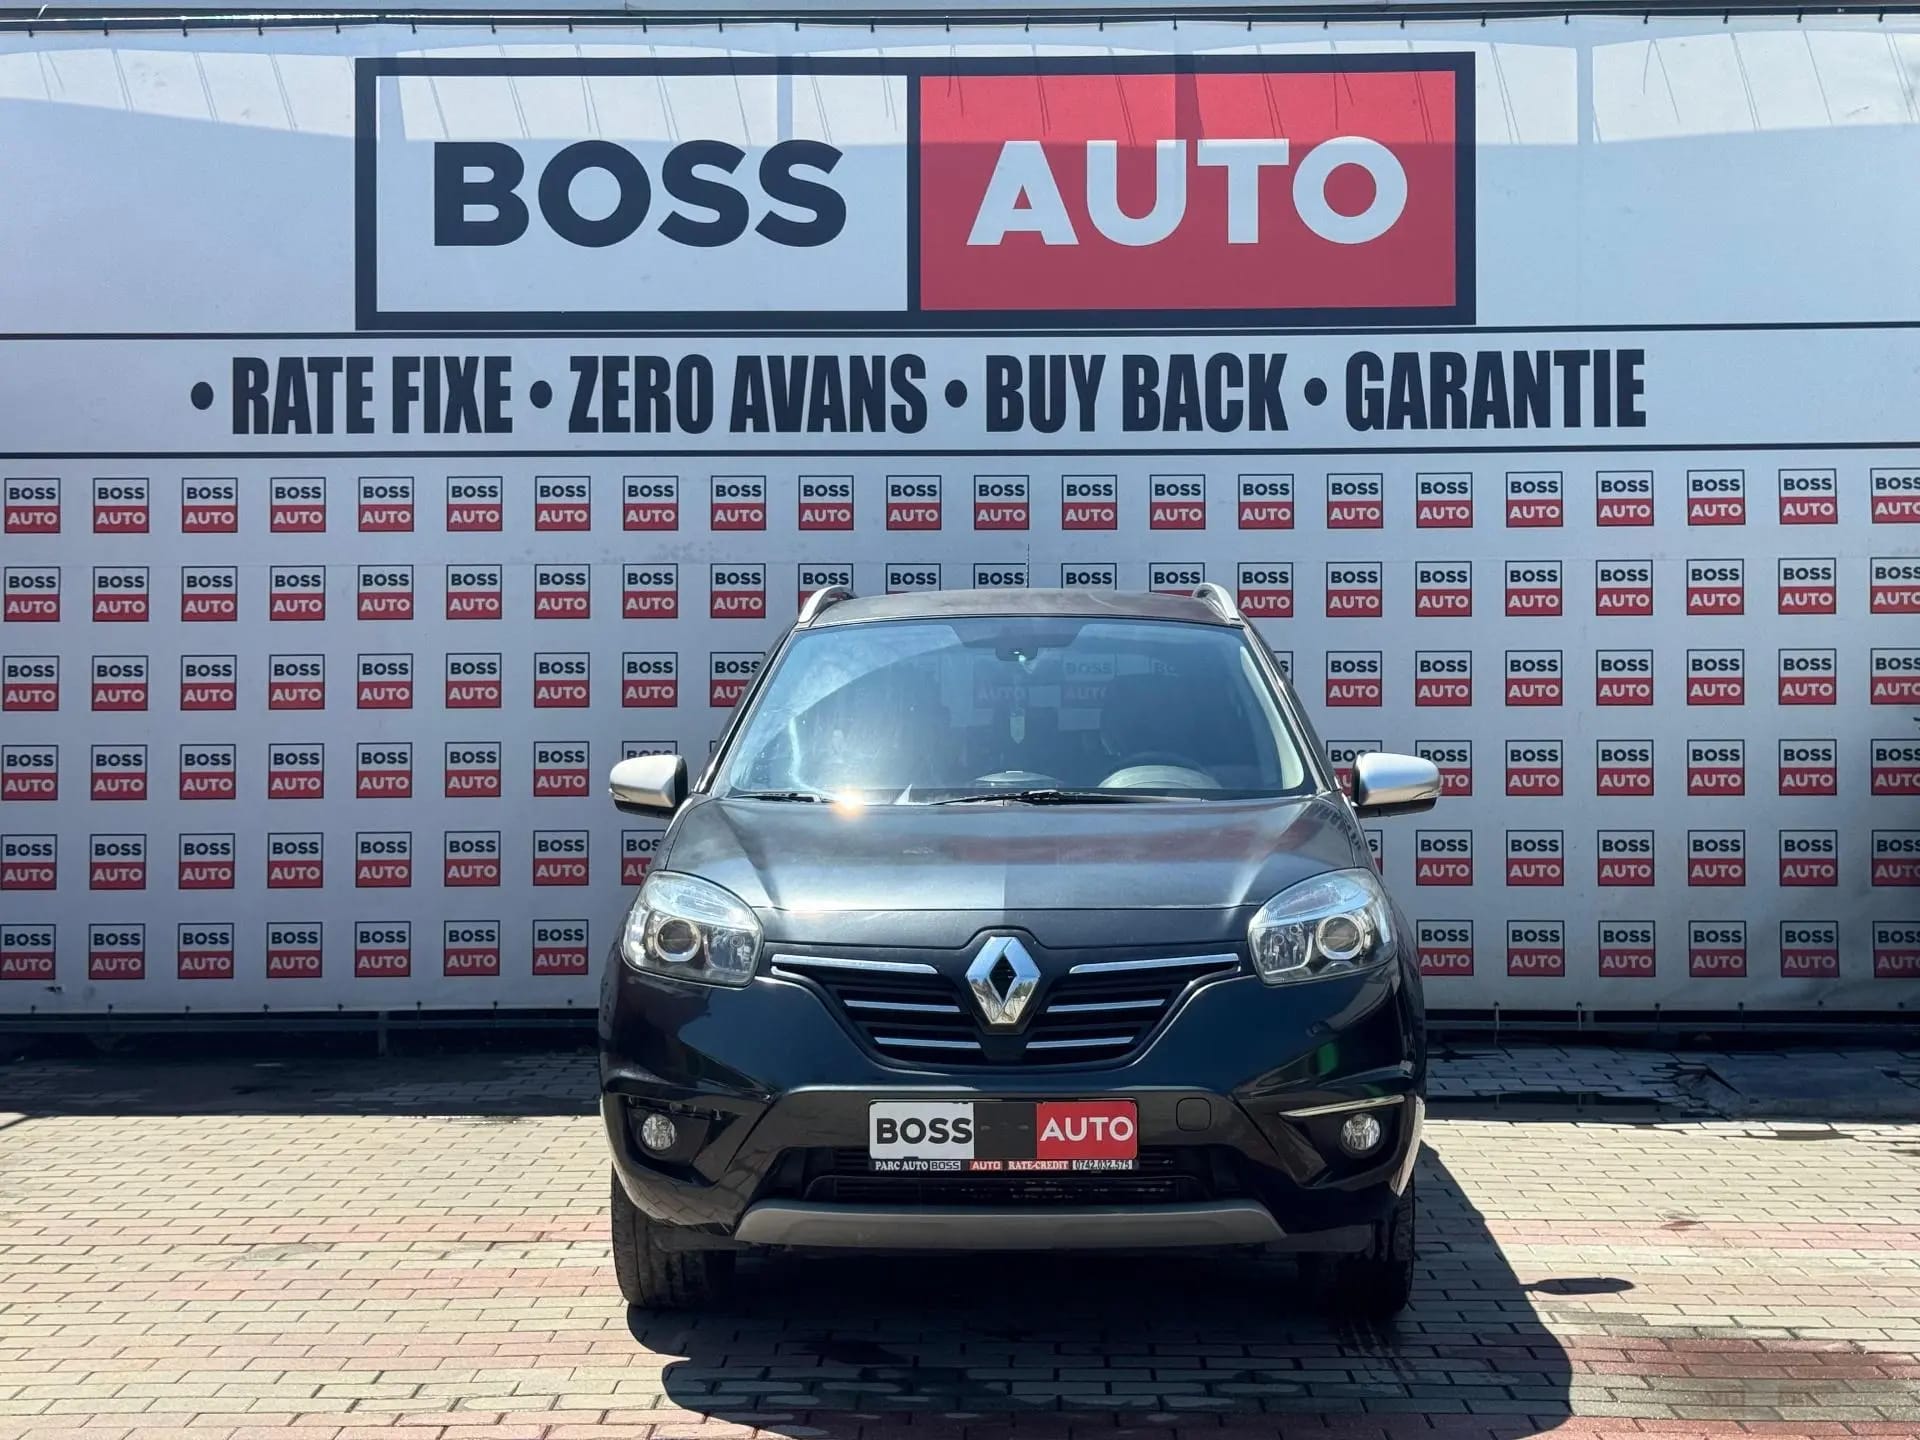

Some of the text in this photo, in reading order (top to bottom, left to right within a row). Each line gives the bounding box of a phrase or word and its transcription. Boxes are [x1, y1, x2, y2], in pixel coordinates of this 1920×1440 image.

[435, 136, 1407, 247] BOSS AUTO
[233, 349, 1646, 434] RATE FIXE ZERO AVANS BUY BACK GARANTIE
[891, 484, 938, 496] BOSS
[979, 484, 1025, 496] BOSS
[1067, 483, 1113, 496] BOSS
[1243, 483, 1290, 495] BOSS
[1332, 482, 1379, 495] BOSS
[1421, 481, 1469, 494] BOSS
[1602, 479, 1649, 492] BOSS
[1693, 478, 1741, 491] BOSS
[1784, 477, 1833, 490] BOSS
[10, 487, 57, 499] BOSS
[187, 486, 234, 499] BOSS
[276, 486, 322, 499] BOSS
[364, 485, 410, 498] BOSS
[540, 485, 587, 497] BOSS
[628, 484, 674, 497] BOSS
[716, 484, 762, 497] BOSS
[714, 510, 763, 521] AUTO
[890, 510, 938, 521] AUTO
[978, 509, 1026, 521] AUTO
[1066, 509, 1114, 521] AUTO
[1241, 507, 1292, 521] AUTO
[1330, 506, 1381, 520] AUTO
[1419, 505, 1470, 519] AUTO
[1600, 504, 1651, 518] AUTO
[1691, 503, 1742, 517] AUTO
[1783, 502, 1834, 516] AUTO
[8, 512, 57, 524] AUTO
[186, 512, 234, 524] AUTO
[274, 512, 322, 524] AUTO
[362, 511, 411, 523] AUTO
[538, 510, 587, 522] AUTO
[626, 510, 675, 522] AUTO
[187, 575, 233, 587] BOSS
[275, 574, 321, 587] BOSS
[452, 573, 498, 585] BOSS
[540, 572, 586, 585] BOSS
[803, 571, 850, 586] BOSS
[891, 571, 938, 586] BOSS
[979, 571, 1026, 586] BOSS
[1066, 571, 1113, 586] BOSS
[1154, 571, 1201, 586] BOSS
[1243, 571, 1289, 583] BOSS
[1331, 570, 1378, 583] BOSS
[1511, 569, 1558, 582] BOSS
[1601, 568, 1649, 581] BOSS
[1692, 568, 1740, 581] BOSS
[98, 575, 145, 588] BOSS
[450, 598, 499, 611] AUTO
[538, 598, 586, 610] AUTO
[1240, 595, 1291, 609] AUTO
[1329, 595, 1380, 609] AUTO
[1509, 593, 1560, 607] AUTO
[1599, 593, 1650, 607] AUTO
[1690, 592, 1741, 606] AUTO
[96, 601, 145, 613] AUTO
[185, 600, 234, 612] AUTO
[273, 600, 322, 612] AUTO
[274, 663, 321, 676] BOSS
[363, 662, 409, 675] BOSS
[451, 662, 498, 674] BOSS
[628, 661, 674, 673] BOSS
[1331, 660, 1378, 672] BOSS
[1421, 659, 1468, 672] BOSS
[1511, 659, 1559, 672] BOSS
[1692, 658, 1740, 671] BOSS
[1784, 657, 1832, 670] BOSS
[8, 664, 55, 677] BOSS
[97, 664, 144, 677] BOSS
[272, 689, 321, 701] AUTO
[360, 688, 409, 700] AUTO
[449, 687, 498, 699] AUTO
[626, 687, 674, 698] AUTO
[1329, 684, 1380, 698] AUTO
[1419, 684, 1470, 698] AUTO
[1509, 683, 1560, 697] AUTO
[1691, 682, 1742, 696] AUTO
[1783, 682, 1834, 696] AUTO
[6, 690, 55, 702] AUTO
[95, 690, 144, 702] AUTO
[96, 753, 143, 766] BOSS
[185, 753, 232, 765] BOSS
[274, 752, 320, 765] BOSS
[450, 750, 497, 763] BOSS
[539, 750, 585, 763] BOSS
[1511, 749, 1559, 761] BOSS
[1602, 748, 1650, 761] BOSS
[1693, 748, 1741, 761] BOSS
[94, 779, 144, 791] AUTO
[183, 779, 232, 791] AUTO
[272, 778, 320, 790] AUTO
[448, 776, 497, 788] AUTO
[537, 776, 585, 788] AUTO
[1509, 773, 1560, 787] AUTO
[1600, 773, 1651, 787] AUTO
[1691, 773, 1742, 787] AUTO
[6, 843, 53, 856] BOSS
[95, 843, 142, 856] BOSS
[184, 842, 231, 855] BOSS
[361, 840, 408, 853] BOSS
[450, 839, 497, 852] BOSS
[539, 839, 585, 852] BOSS
[1421, 838, 1469, 851] BOSS
[1512, 839, 1559, 851] BOSS
[1603, 839, 1650, 852] BOSS
[1785, 839, 1833, 852] BOSS
[4, 869, 53, 881] AUTO
[93, 869, 142, 881] AUTO
[182, 868, 231, 880] AUTO
[359, 866, 408, 879] AUTO
[448, 865, 497, 878] AUTO
[536, 864, 585, 877] AUTO
[1419, 863, 1470, 877] AUTO
[1510, 863, 1561, 877] AUTO
[1601, 863, 1652, 877] AUTO
[1784, 863, 1835, 877] AUTO
[5, 933, 52, 945] BOSS
[183, 932, 230, 944] BOSS
[272, 931, 318, 944] BOSS
[360, 930, 407, 943] BOSS
[538, 928, 585, 941] BOSS
[1422, 928, 1469, 942] BOSS
[1604, 929, 1651, 942] BOSS
[1694, 930, 1742, 942] BOSS
[1786, 930, 1835, 943] BOSS
[3, 959, 52, 971] AUTO
[181, 958, 230, 970] AUTO
[270, 956, 319, 969] AUTO
[359, 956, 407, 968] AUTO
[536, 954, 585, 966] AUTO
[1420, 953, 1471, 967] AUTO
[1602, 954, 1653, 968] AUTO
[1693, 954, 1744, 968] AUTO
[1784, 954, 1835, 968] AUTO
[876, 1116, 1134, 1144] BOSS AUTO
[875, 1160, 900, 1171] PARC
[902, 1160, 928, 1171] AUTO
[931, 1161, 960, 1170] BOSS
[972, 1161, 1001, 1171] AUTO
